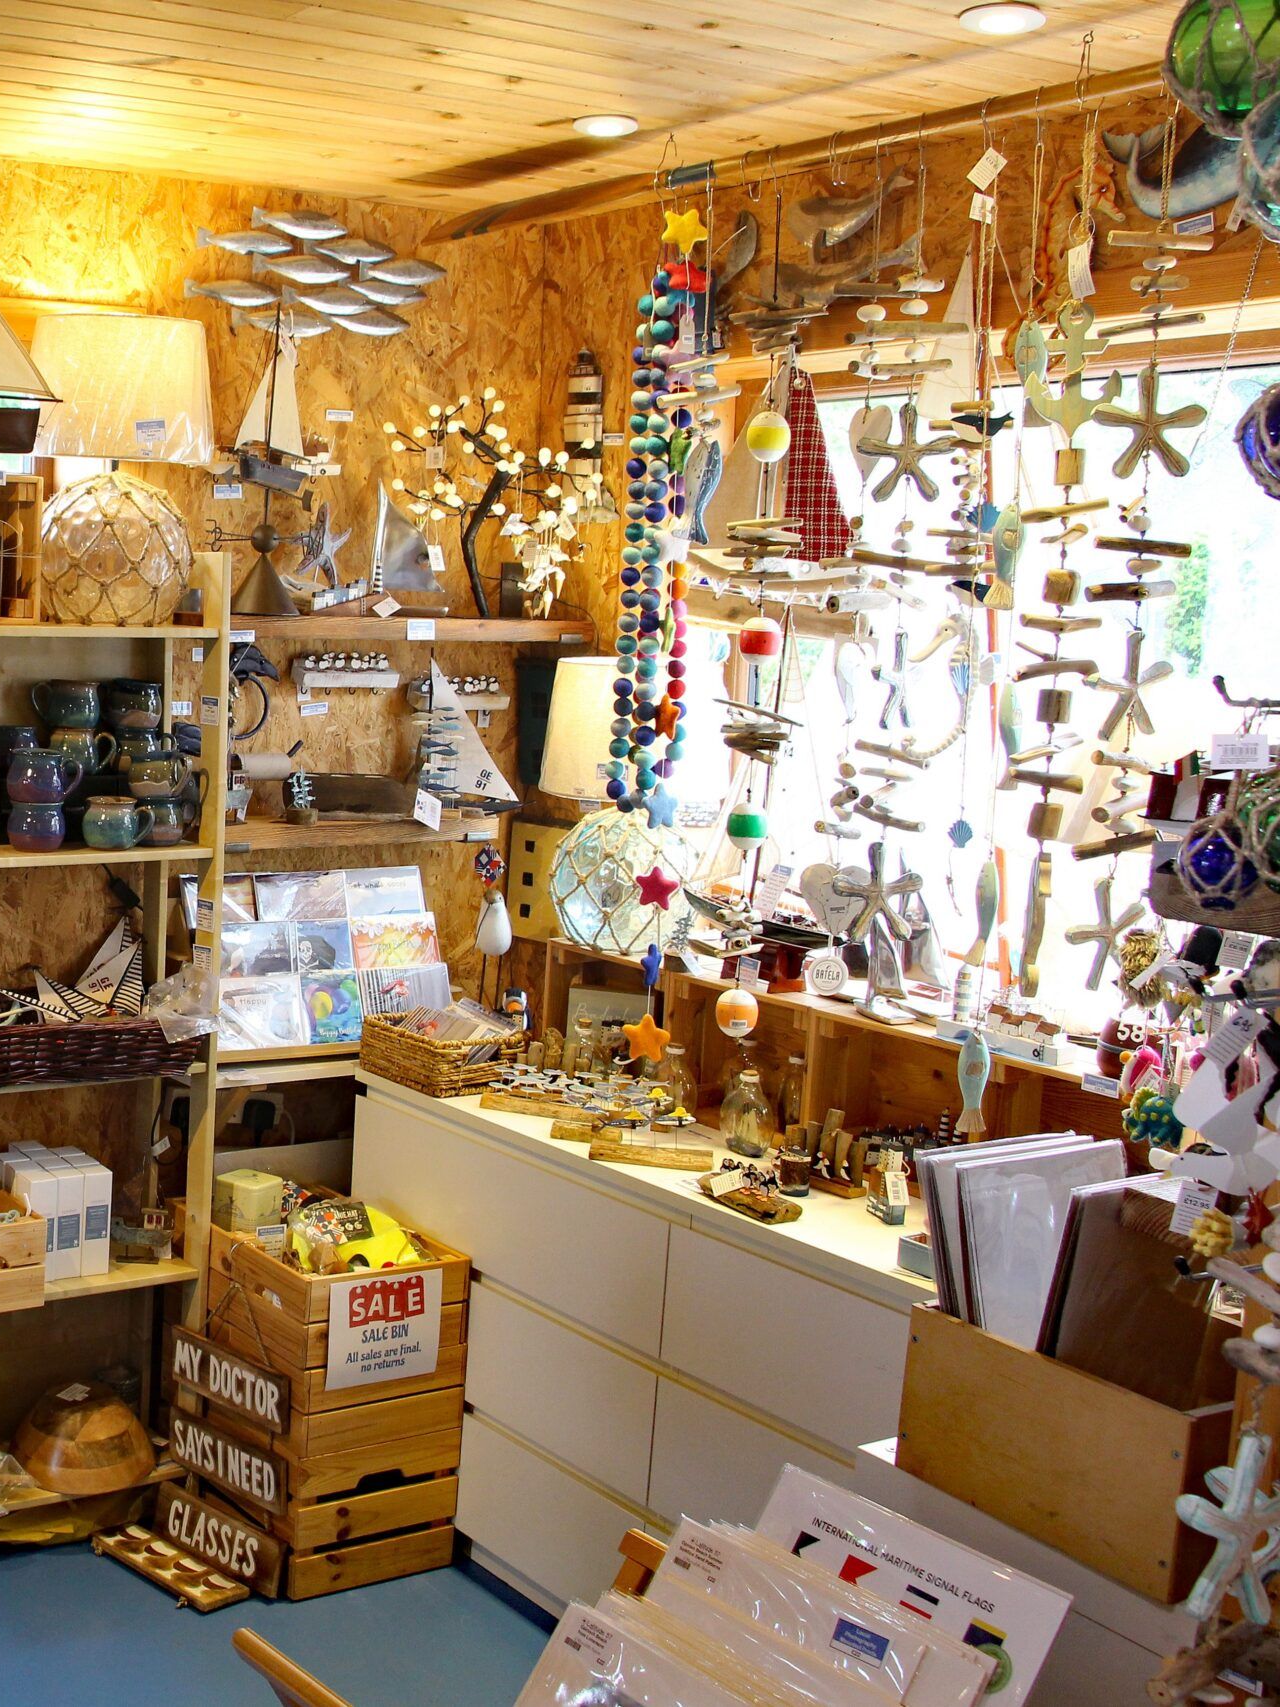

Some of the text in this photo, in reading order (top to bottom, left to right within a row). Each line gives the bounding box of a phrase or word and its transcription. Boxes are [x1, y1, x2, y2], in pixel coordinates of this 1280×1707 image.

[480, 768, 494, 780] GE
[474, 780, 488, 791] 91
[816, 968, 840, 980] BATELA
[1116, 1021, 1146, 1043] 58
[352, 1287, 422, 1322] SALE
[362, 1324, 410, 1344] SALE BIN
[346, 1352, 359, 1364] All
[360, 1348, 382, 1362] sales
[384, 1348, 398, 1358] are
[360, 1358, 406, 1373] no returns
[174, 1339, 280, 1424] MY DOCTOR
[174, 1419, 276, 1501] SAYS I NEED
[168, 1499, 260, 1577] GLASSES
[880, 1552, 926, 1580] MARITIME
[925, 1572, 966, 1598] SIGNAL
[962, 1590, 996, 1614] FLAGS
